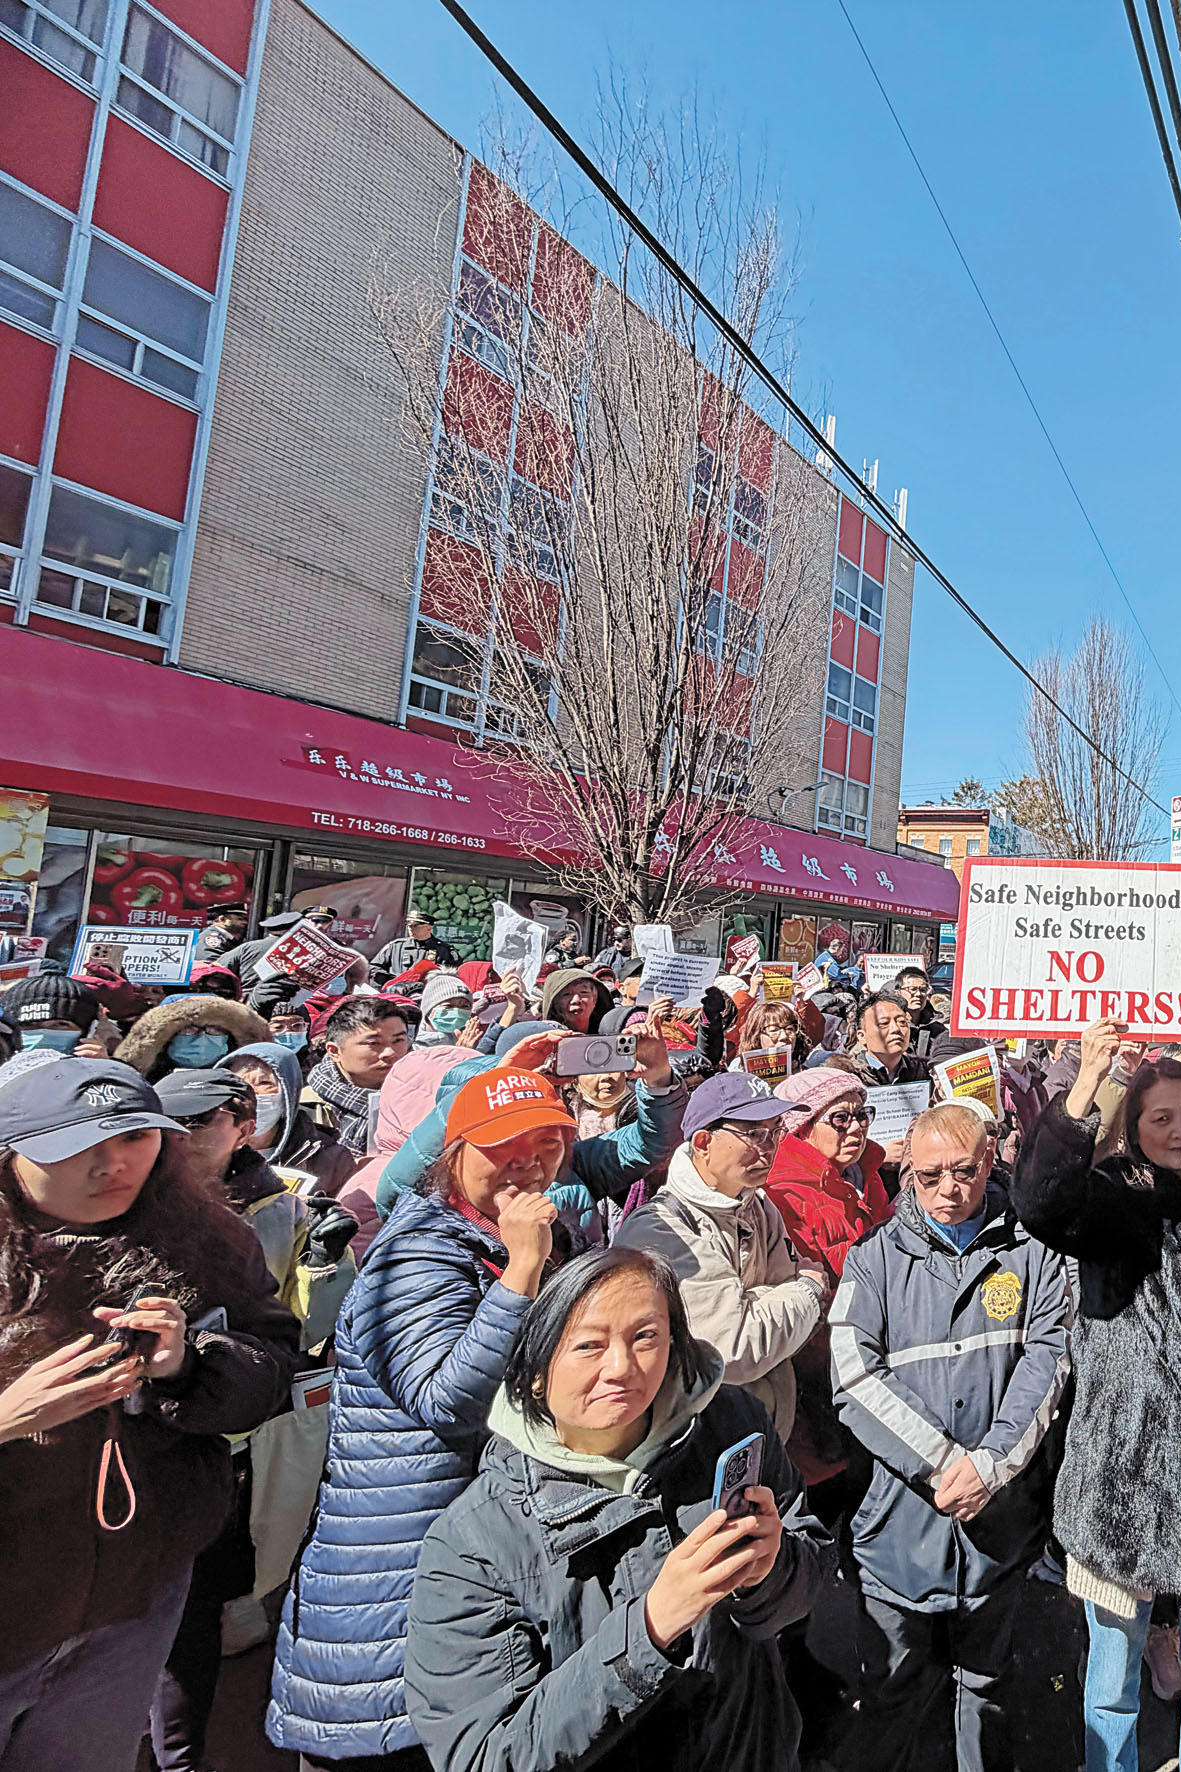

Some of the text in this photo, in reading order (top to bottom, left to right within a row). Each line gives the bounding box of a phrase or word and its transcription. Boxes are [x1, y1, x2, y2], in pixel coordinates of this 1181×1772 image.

[338, 770, 471, 803] V & W SUPERMARKET NY INC
[312, 811, 344, 828] TEL:
[347, 817, 429, 841] 718-266-1668
[437, 832, 486, 849] 266-1633
[969, 882, 1017, 905] Safe
[1014, 917, 1146, 941] Safe Streets
[124, 955, 158, 964] PTION
[292, 931, 346, 969] NEIGHBORS
[299, 962, 332, 981] PRICE!
[305, 953, 339, 975] PAY THE
[1046, 950, 1105, 984] NO
[753, 1056, 779, 1066] MAYOR
[956, 1060, 982, 1072] MAYOR
[485, 1075, 537, 1098] LARRY
[953, 1067, 991, 1085] MAMDANI
[488, 1090, 513, 1110] HE
